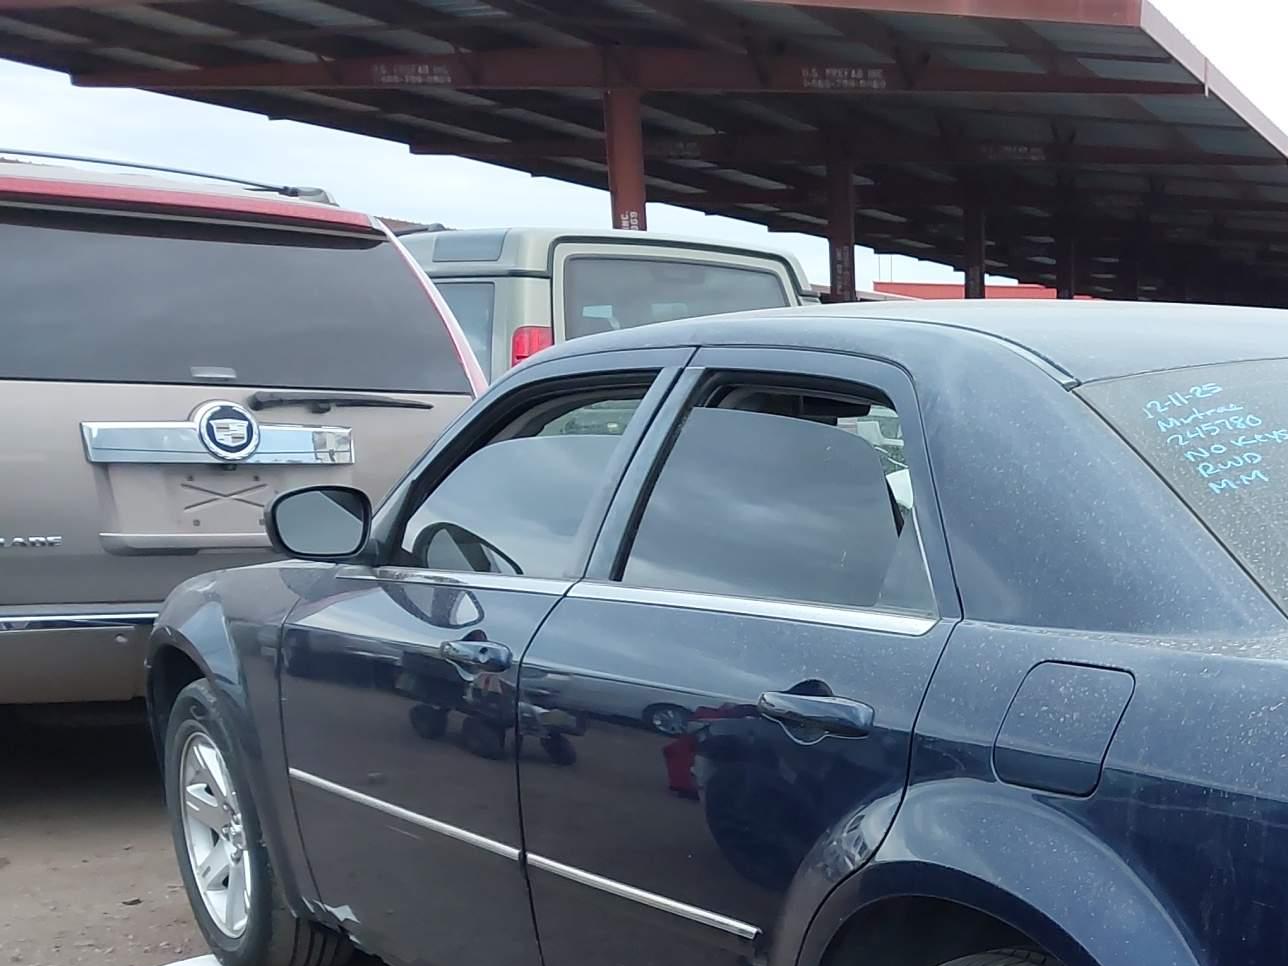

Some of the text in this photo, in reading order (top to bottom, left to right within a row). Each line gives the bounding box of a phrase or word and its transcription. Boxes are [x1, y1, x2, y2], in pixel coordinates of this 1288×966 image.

[1142, 382, 1223, 419] 12-11-25
[1166, 414, 1263, 446] 245780
[1197, 452, 1263, 478] RWD
